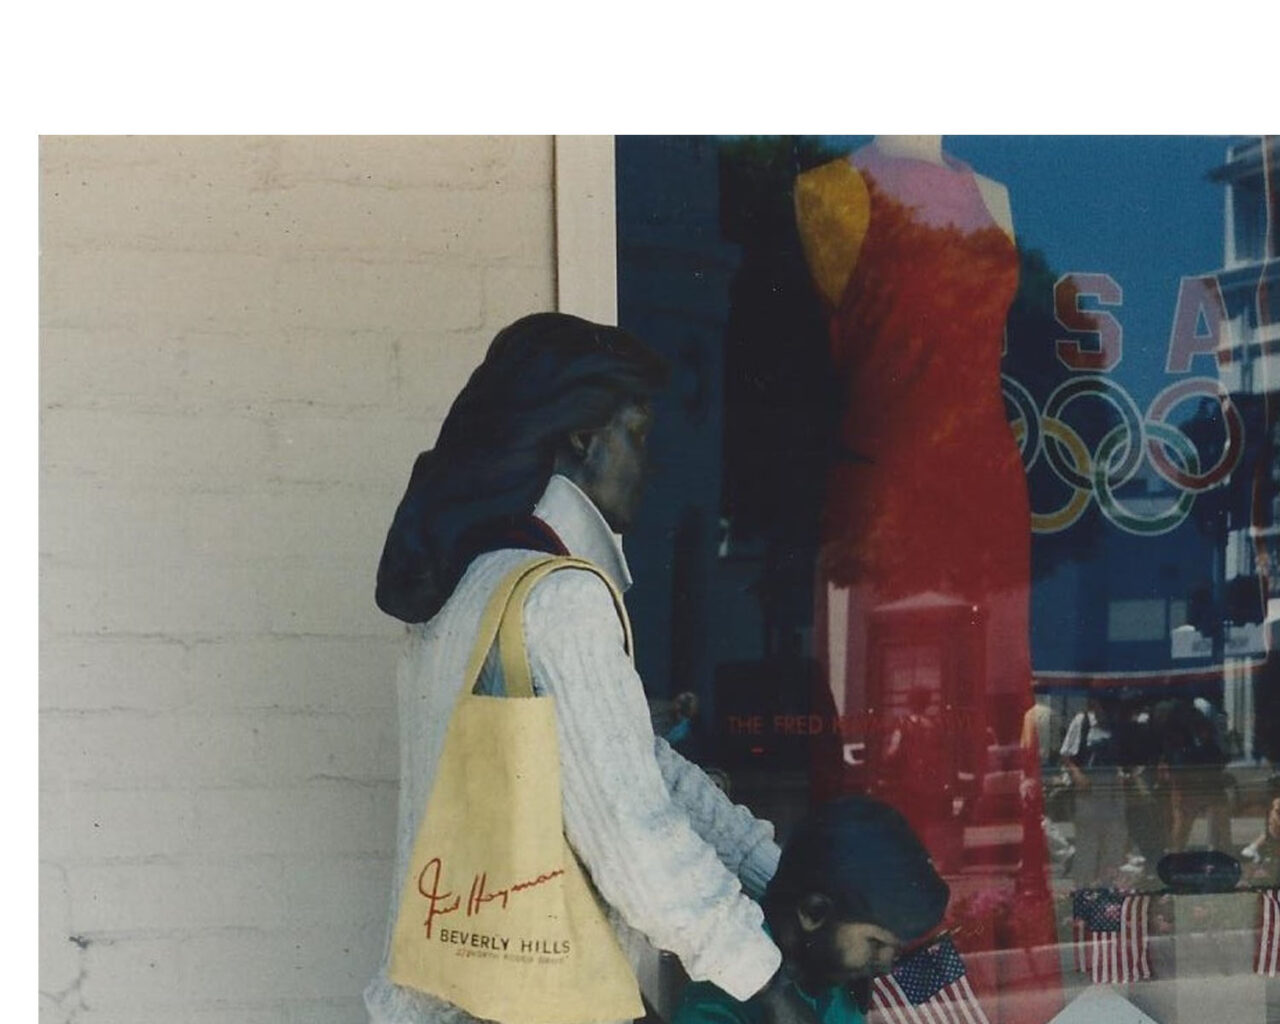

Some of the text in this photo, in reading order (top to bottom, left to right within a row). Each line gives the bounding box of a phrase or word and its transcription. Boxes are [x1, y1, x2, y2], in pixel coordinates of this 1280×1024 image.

[1000, 271, 1235, 374] SA
[727, 715, 763, 736] THE
[773, 715, 824, 735] FRED
[439, 928, 571, 955] BEVERLY HILLS
